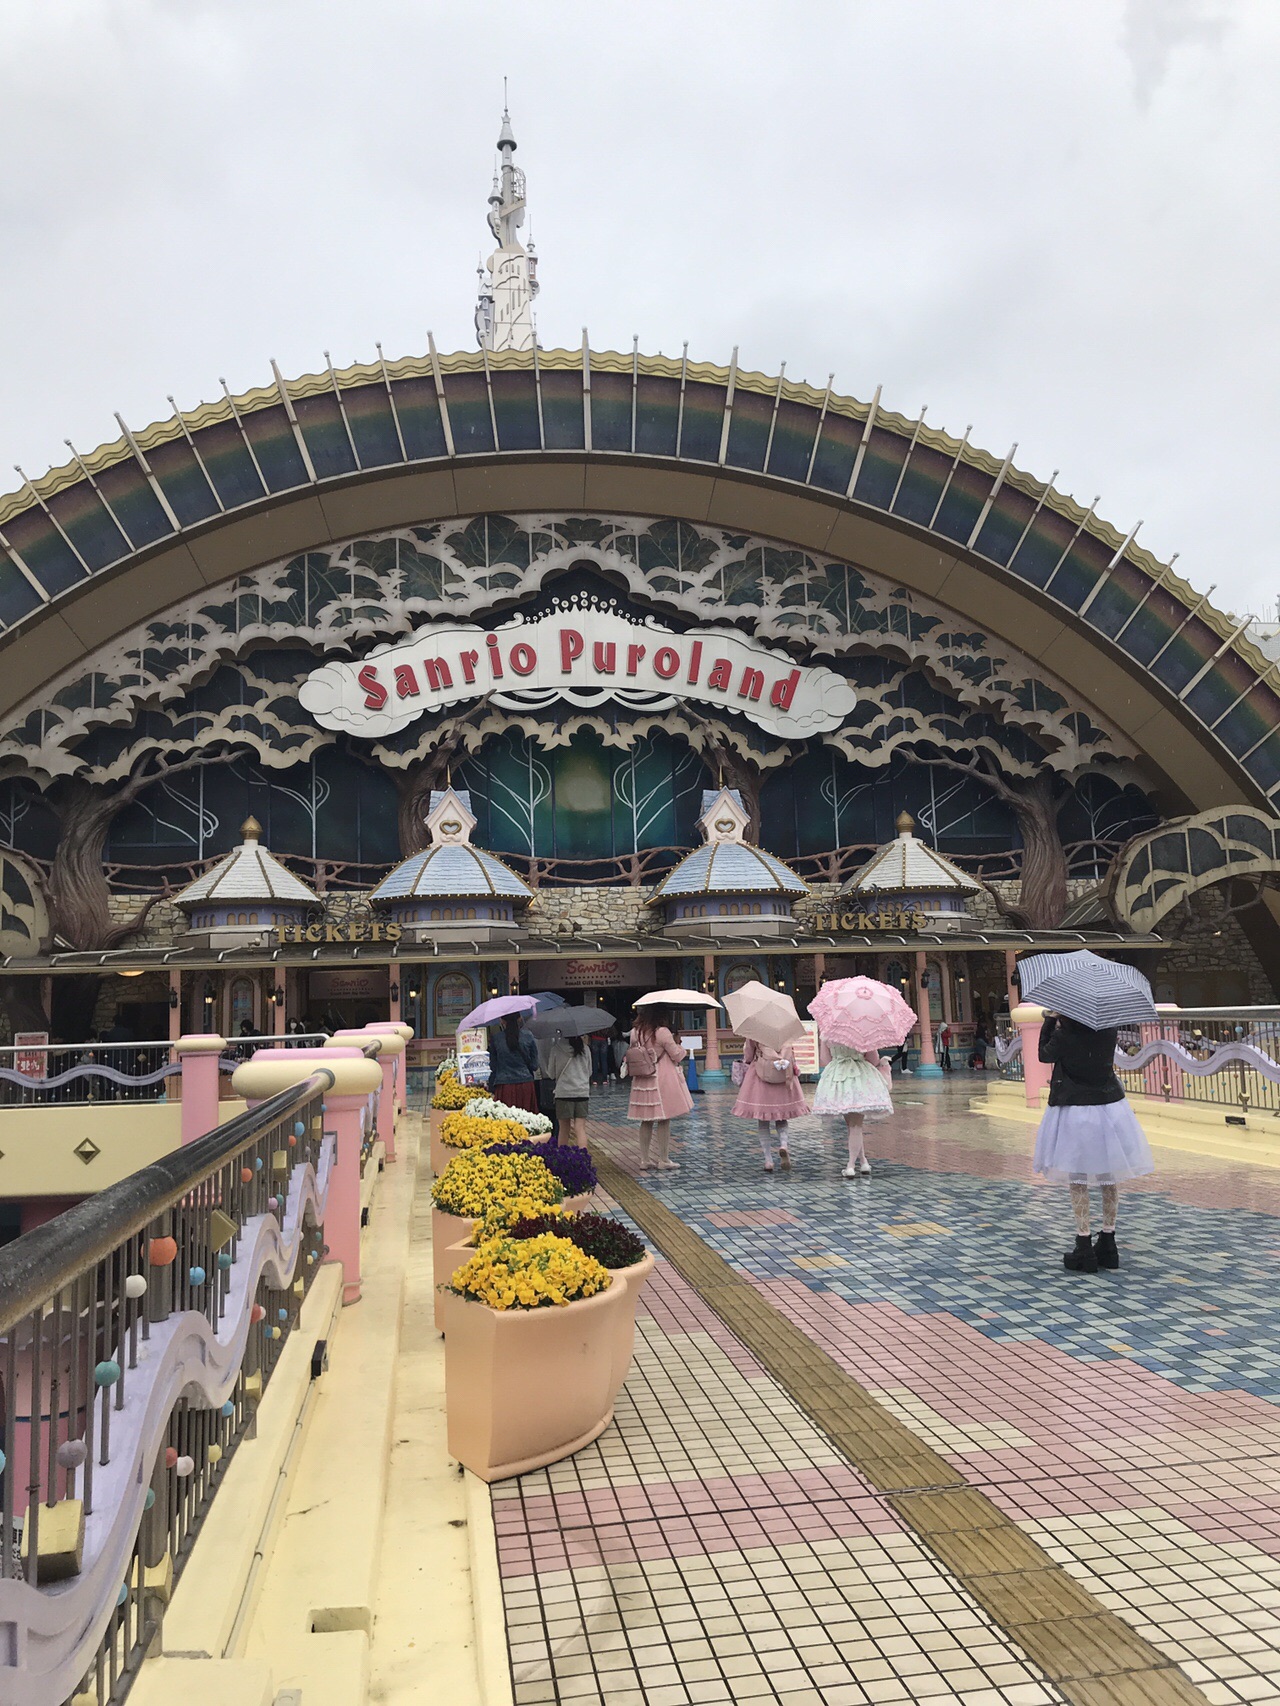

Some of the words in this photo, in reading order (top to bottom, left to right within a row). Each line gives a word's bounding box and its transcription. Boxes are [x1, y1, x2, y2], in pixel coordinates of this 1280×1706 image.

[358, 633, 537, 710] Sanrio
[560, 629, 801, 711] Puroland
[812, 911, 927, 931] TICKETS
[273, 922, 402, 943] TICKETS
[566, 960, 618, 974] Sanrio
